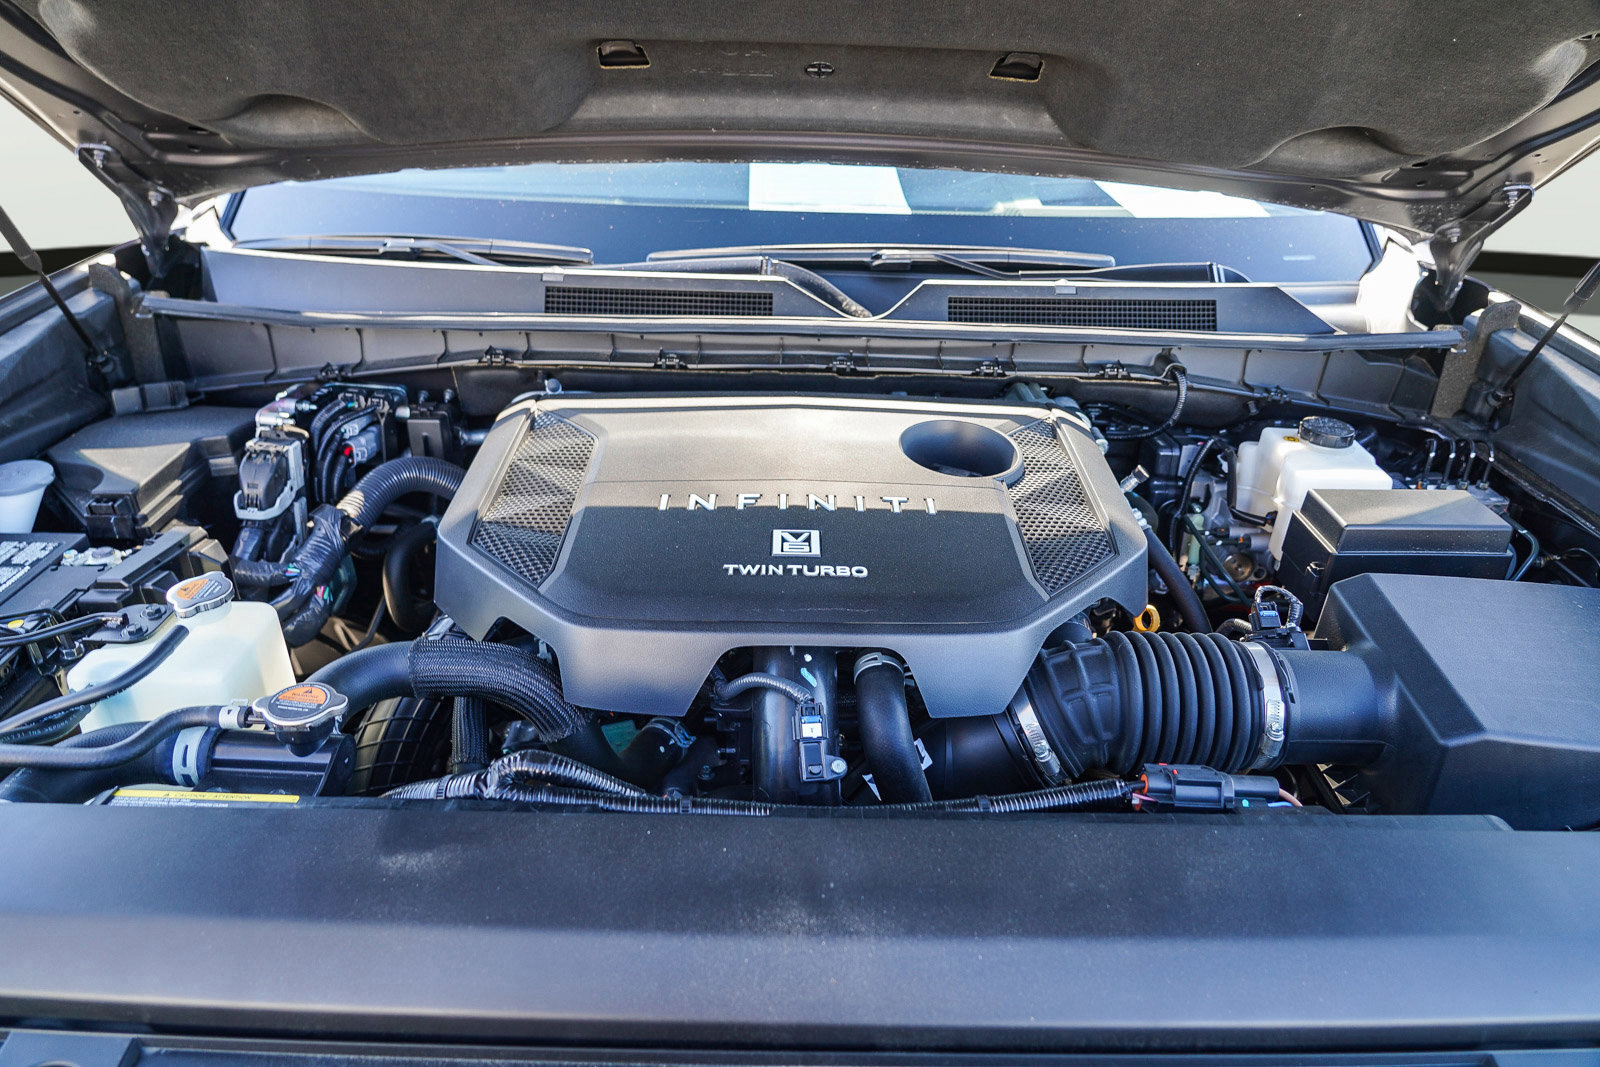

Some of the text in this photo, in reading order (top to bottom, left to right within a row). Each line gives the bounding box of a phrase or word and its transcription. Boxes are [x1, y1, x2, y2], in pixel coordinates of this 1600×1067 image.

[658, 493, 938, 515] INFINITI
[722, 564, 868, 578] TWIN TURBO
